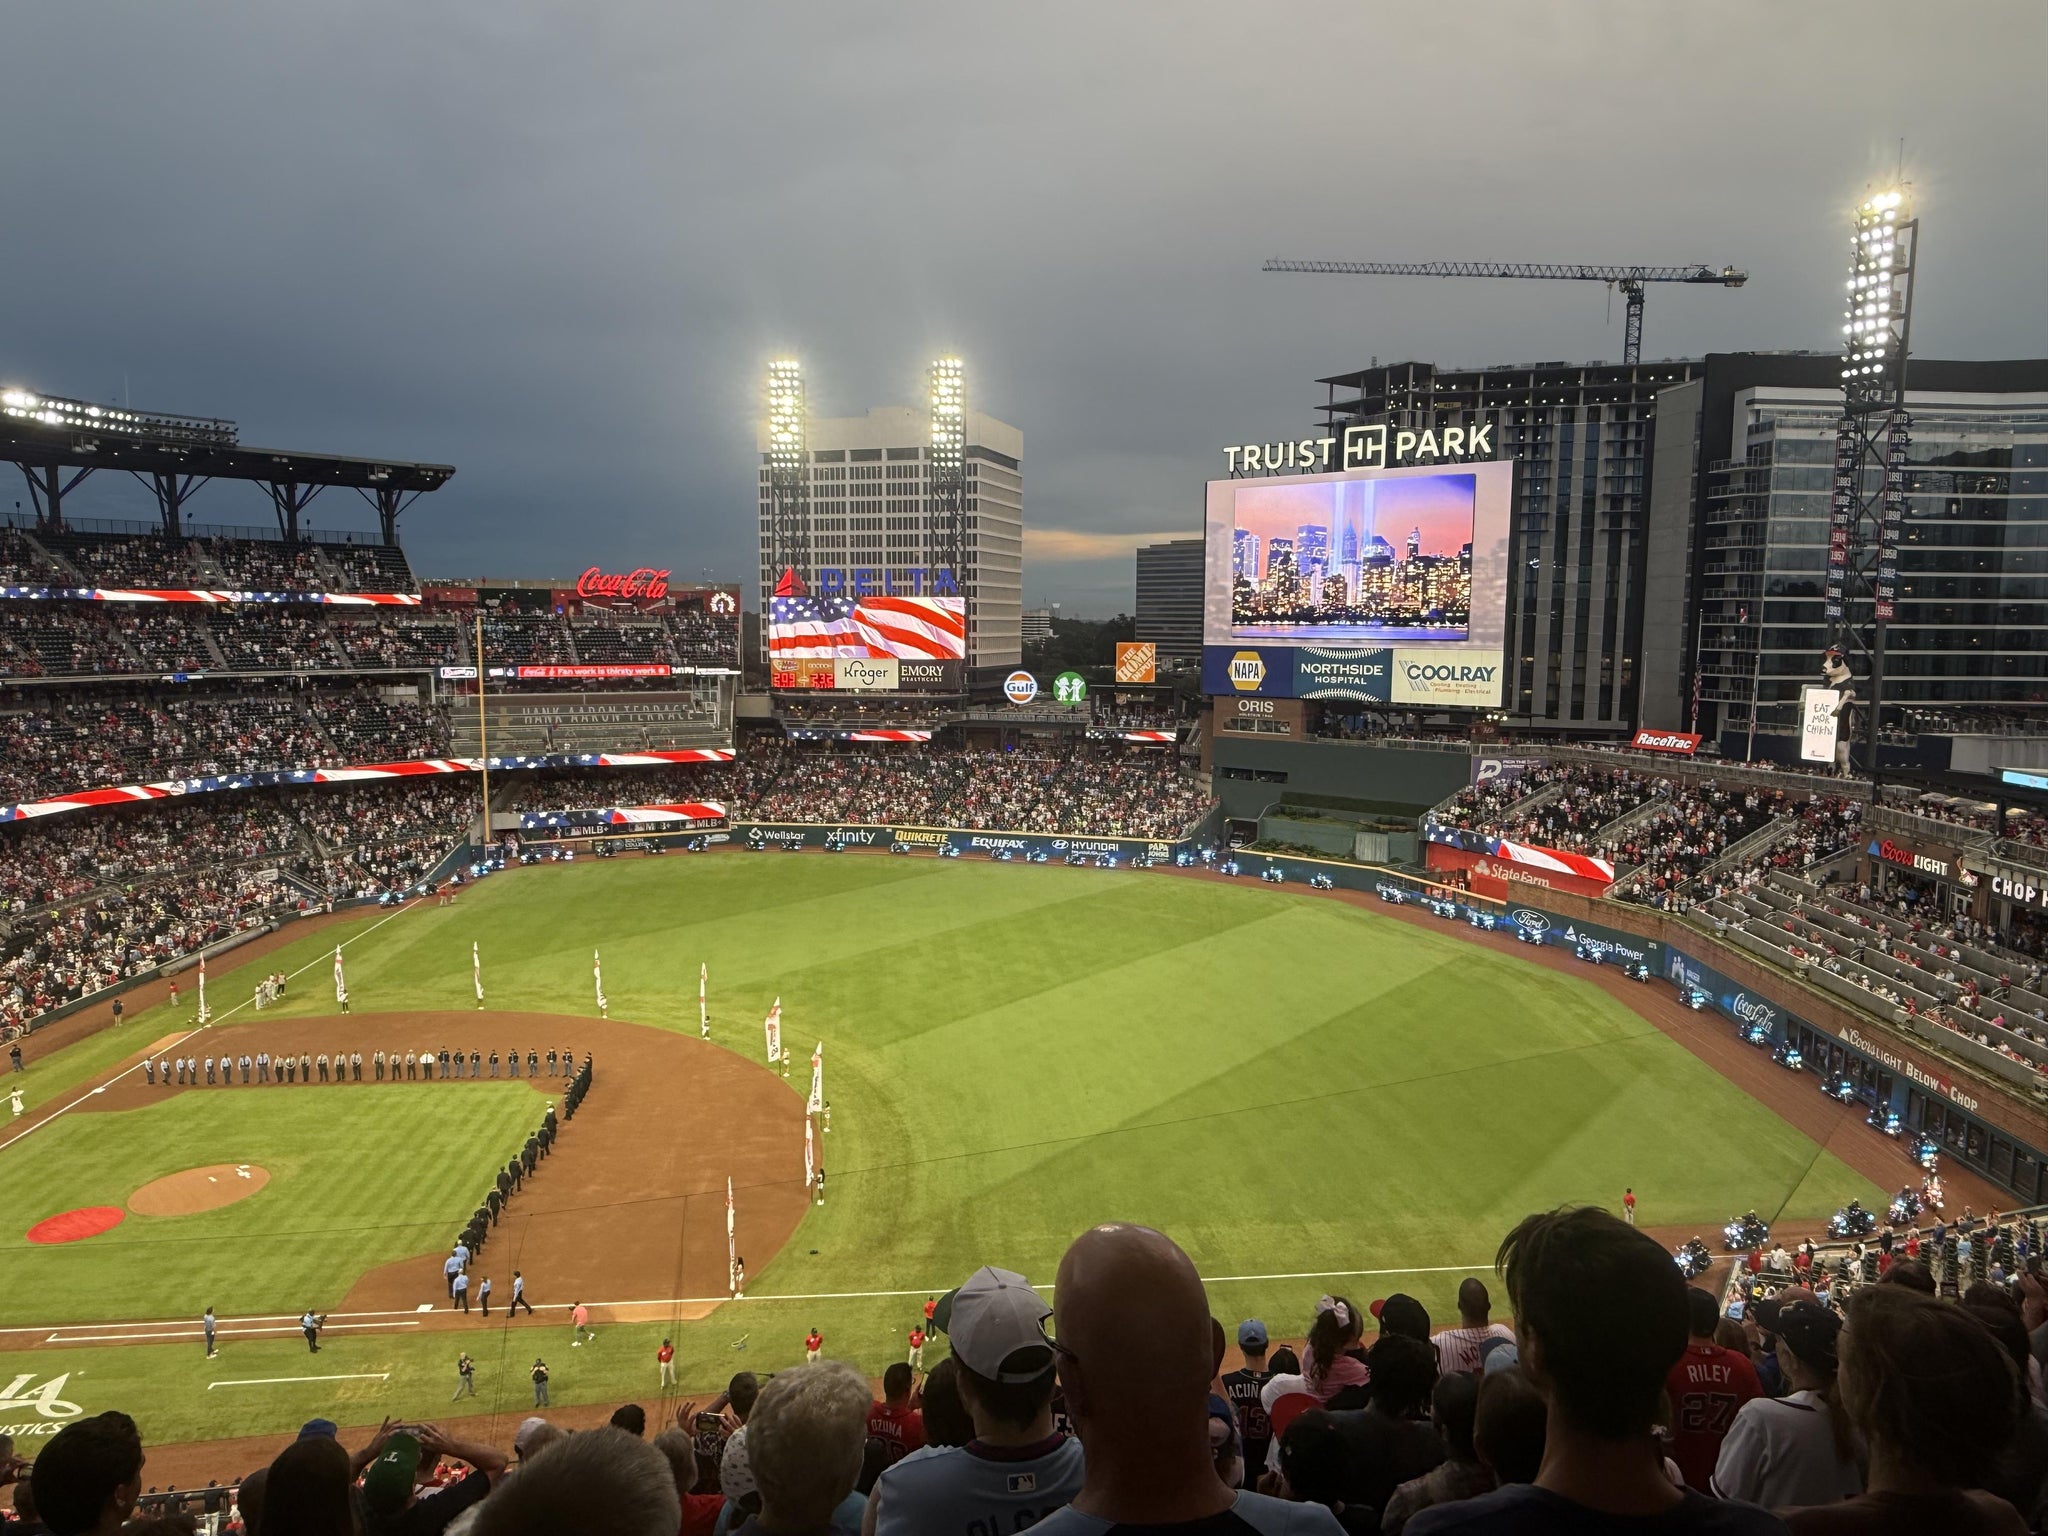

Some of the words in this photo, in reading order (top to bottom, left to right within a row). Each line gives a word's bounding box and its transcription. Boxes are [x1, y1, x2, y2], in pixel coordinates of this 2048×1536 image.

[1223, 437, 1336, 473] TRUIST
[1396, 423, 1494, 460] PARK
[1832, 532, 1847, 543] 1914
[1830, 550, 1845, 561] 1957
[576, 566, 672, 598] Coca-Cola
[821, 568, 958, 593] DELTA
[1828, 587, 1842, 598] 1991
[1879, 586, 1895, 598] 1992
[1826, 605, 1841, 616] 1993
[1877, 605, 1894, 617] 1995
[1116, 643, 1155, 682] HOME
[1119, 647, 1137, 663] THE
[575, 667, 596, 675] work
[598, 667, 605, 675] is
[606, 667, 633, 677] thirsty
[635, 667, 656, 675] work
[844, 660, 889, 686] Kroger
[901, 665, 945, 677] EMORY
[1131, 656, 1155, 682] DEPOT
[1233, 661, 1261, 681] NAPA
[1301, 663, 1383, 676] NORTHSIDE
[1407, 664, 1497, 682] COOLRAY
[1006, 682, 1035, 693] Gulf
[1315, 676, 1367, 685] HOSPITAL
[522, 706, 563, 725] HANK
[568, 705, 620, 723] AARON
[624, 704, 694, 722] TERRACE
[1238, 700, 1274, 713] ORIS
[1814, 703, 1831, 714] EAT
[1637, 733, 1692, 749] RaceTrac
[582, 825, 609, 835] MLB+
[645, 822, 672, 831] MB+
[696, 818, 723, 828] MLB+
[764, 830, 806, 840] Wellstar
[826, 827, 876, 845] xfinity
[895, 830, 949, 843] QUIKRETE
[971, 836, 1025, 849] EQUIFAX
[1072, 841, 1119, 852] HYUNDAI
[1148, 843, 1169, 852] PAPA
[1880, 839, 1913, 866] Coors
[1913, 854, 1950, 876] LIGHT
[1490, 863, 1520, 880] State
[1521, 871, 1550, 887] Farm
[1991, 876, 2037, 903] CHOP
[1518, 911, 1543, 929] Ford
[1579, 933, 1614, 953] Georgia
[1615, 943, 1645, 961] Power
[1849, 1028, 1875, 1056] Coors
[1875, 1050, 1902, 1071] LIGHT
[1905, 1061, 1940, 1091] BELOW
[1949, 1086, 1978, 1112] CHOP
[1686, 1364, 1732, 1384] RILEY
[1228, 1380, 1260, 1399] ACUÑ
[1681, 1391, 1738, 1434] 27
[0, 1421, 67, 1437] ISTICS
[871, 1418, 902, 1440] OZUNA
